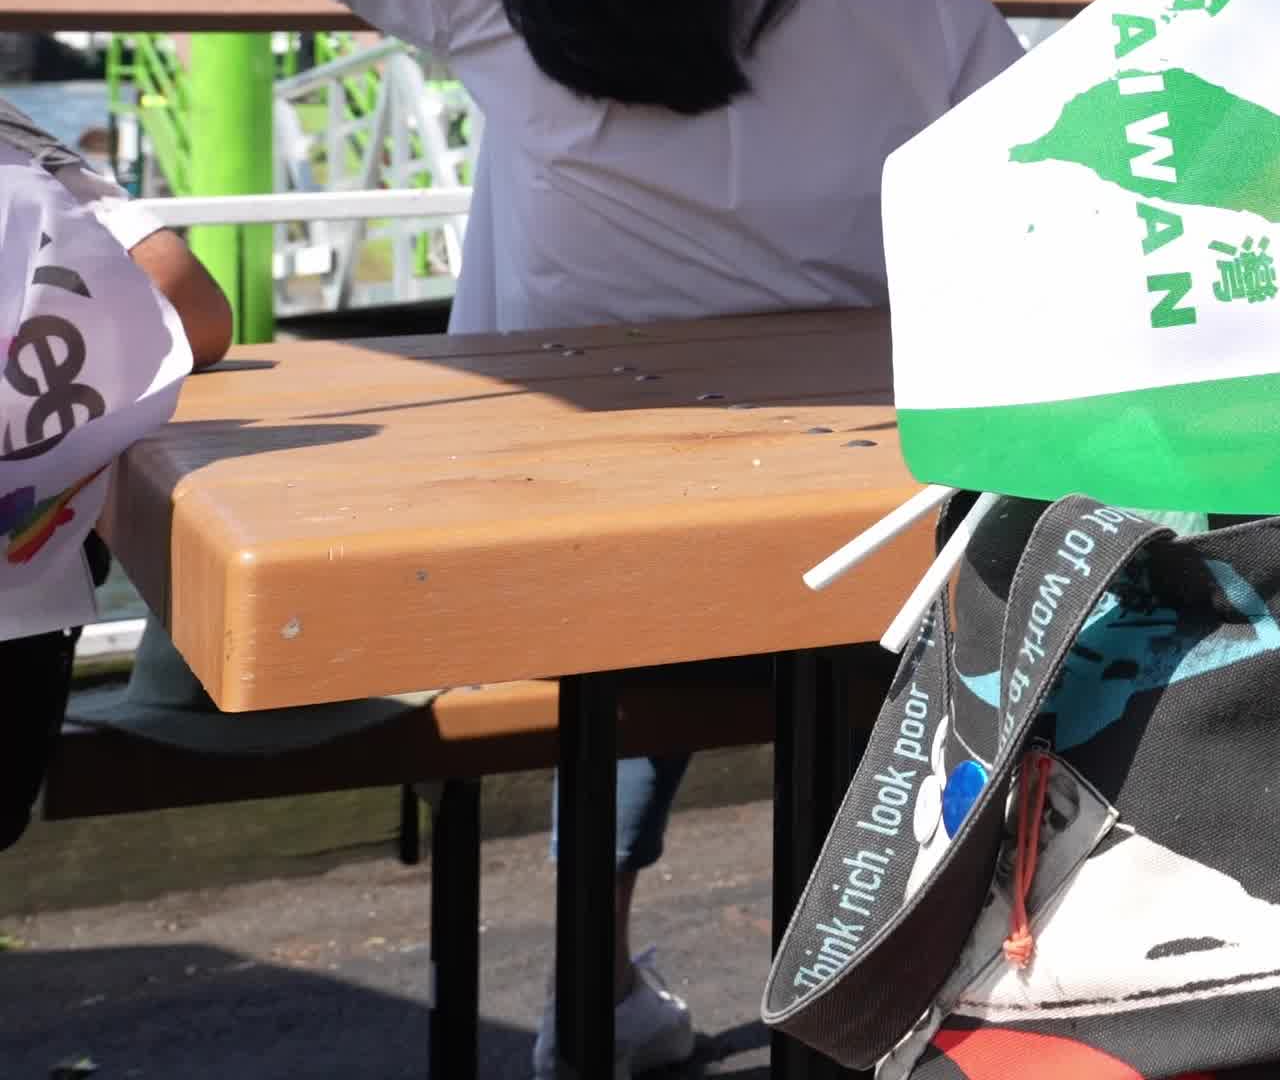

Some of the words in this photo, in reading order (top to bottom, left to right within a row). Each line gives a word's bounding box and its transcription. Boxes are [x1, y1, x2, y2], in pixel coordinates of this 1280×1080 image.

[1057, 529, 1096, 577] of
[1019, 572, 1072, 665] work
[893, 681, 932, 762] poor
[1009, 668, 1031, 704] to
[857, 765, 918, 837] look
[832, 846, 895, 918] rich,
[793, 917, 865, 988] Think
